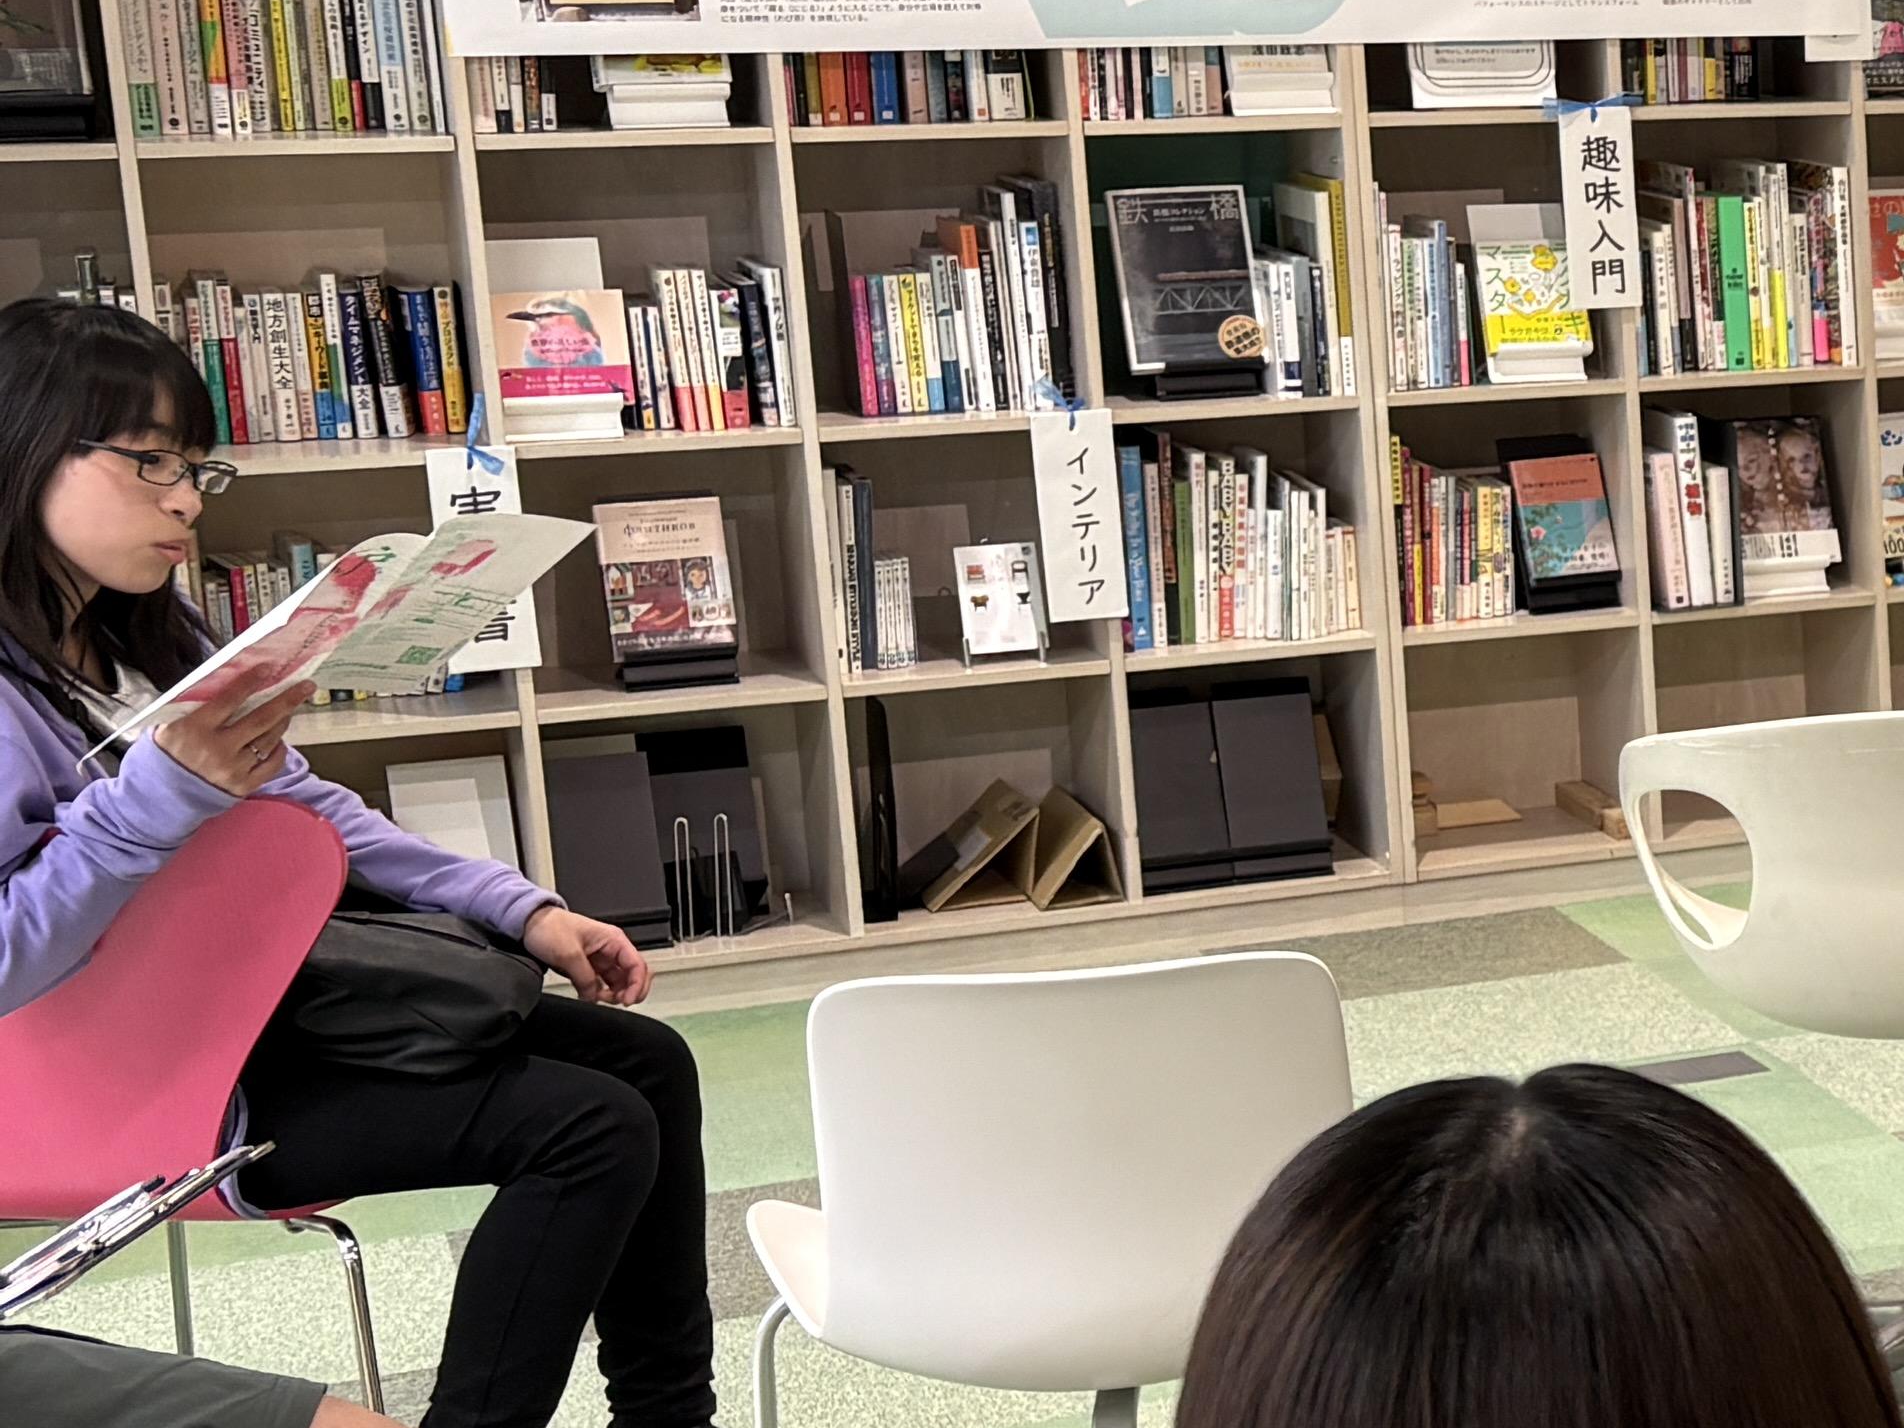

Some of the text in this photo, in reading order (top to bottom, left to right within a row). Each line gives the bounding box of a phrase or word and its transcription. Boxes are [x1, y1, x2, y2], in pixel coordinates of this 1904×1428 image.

[1580, 135, 1627, 295] 趣味入門
[1066, 448, 1105, 606] インテリア
